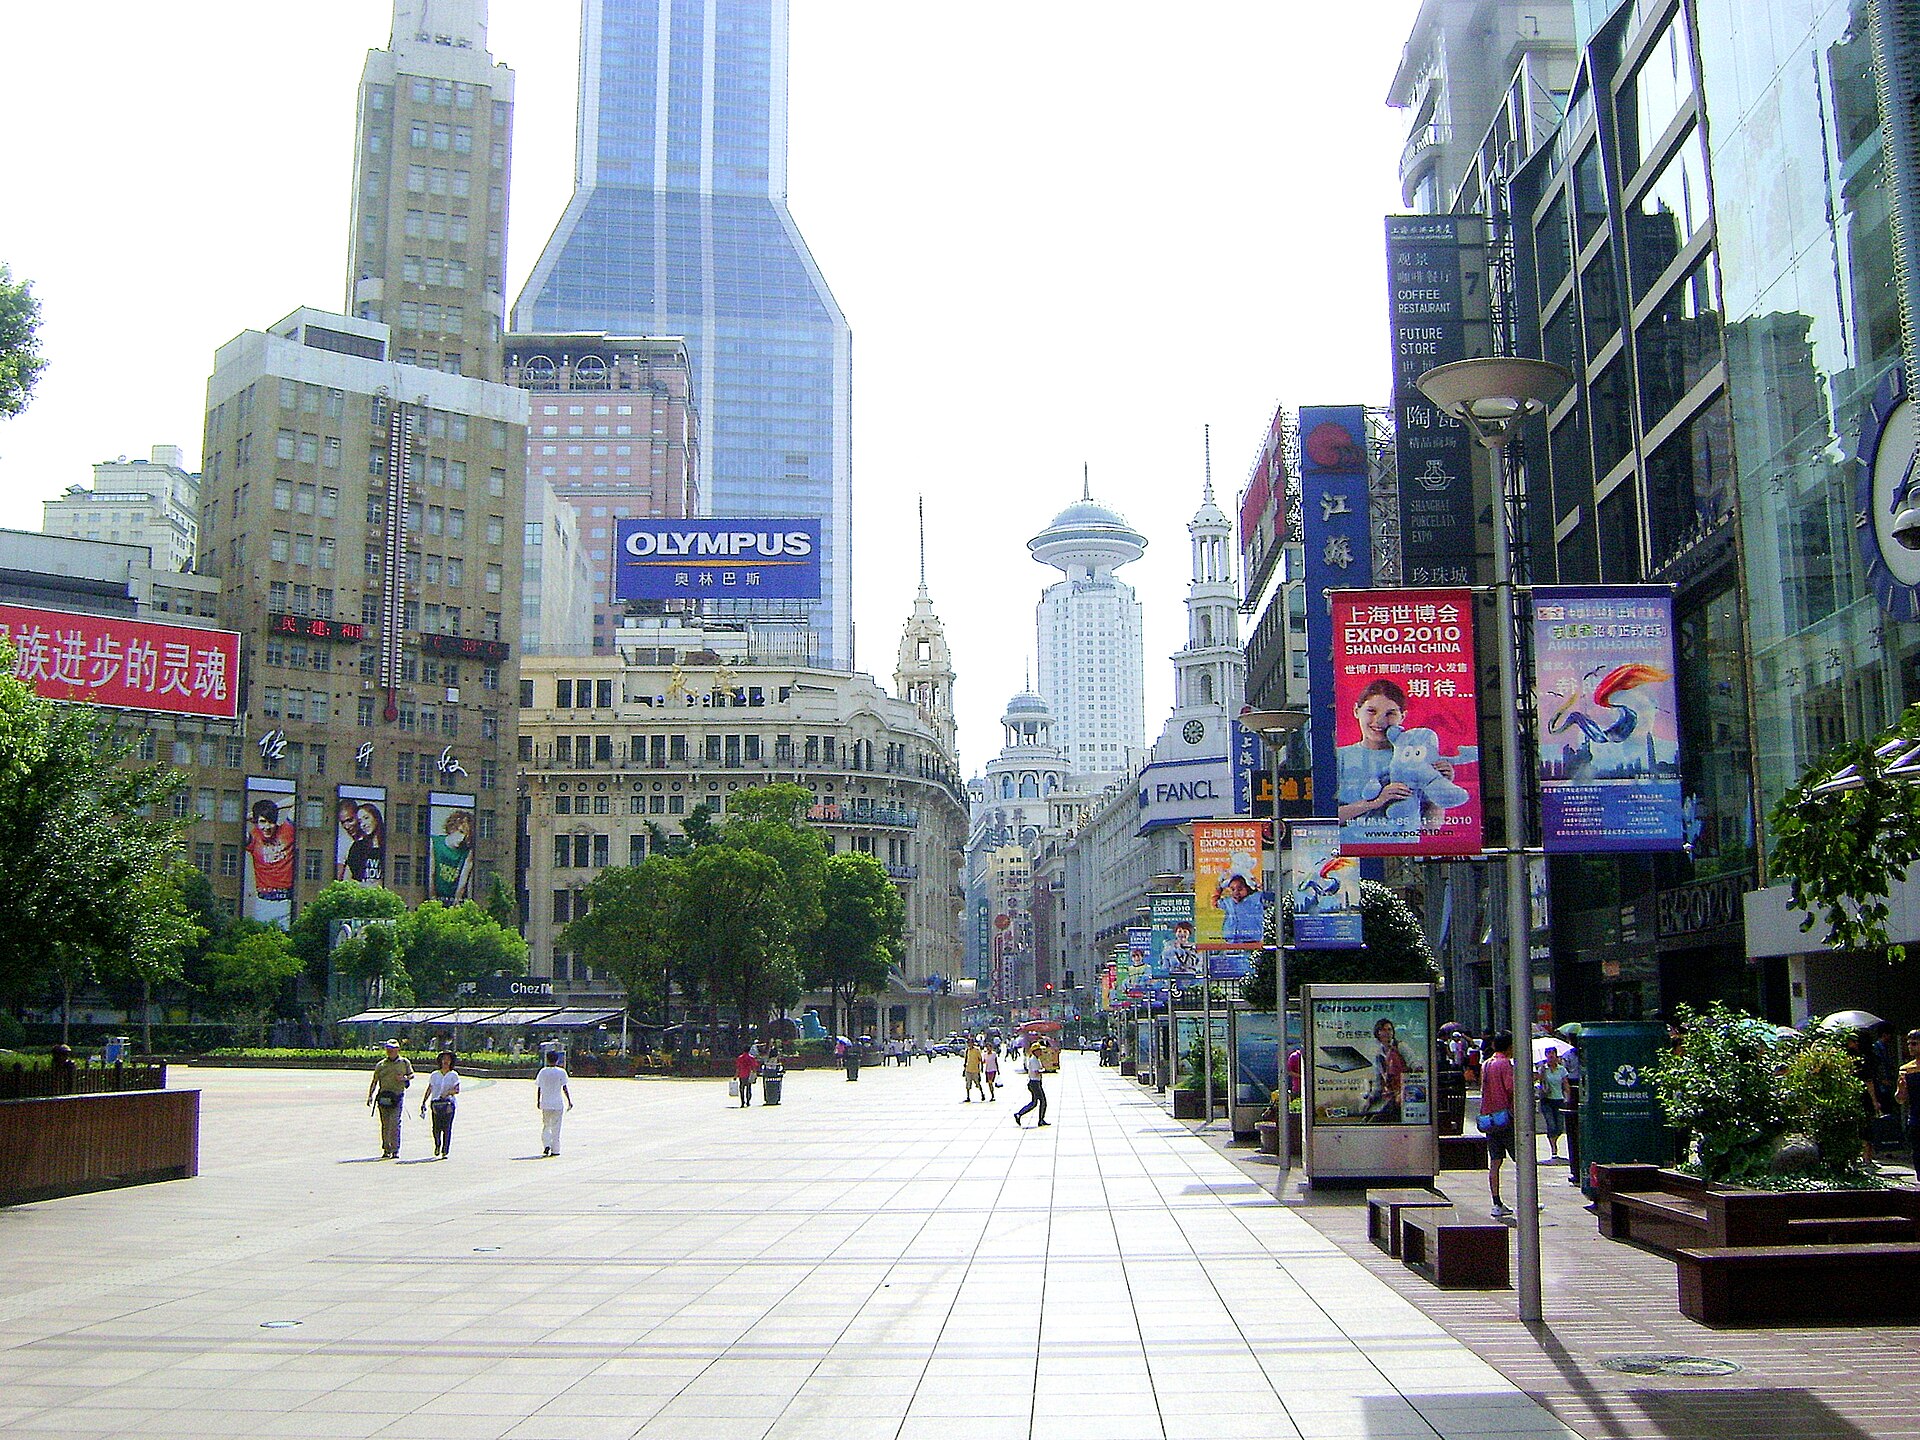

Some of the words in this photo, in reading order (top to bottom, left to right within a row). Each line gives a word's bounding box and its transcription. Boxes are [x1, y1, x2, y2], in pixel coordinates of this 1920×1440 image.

[1398, 289, 1440, 300] COFFEE
[1398, 302, 1451, 314] RESTAURANT
[1399, 328, 1443, 340] FUTURE
[1400, 342, 1437, 355] STORE
[626, 531, 811, 557] OLYMPUS
[675, 572, 760, 587] 奥林巴斯
[1413, 566, 1469, 584] 珍珠城
[1344, 603, 1459, 626] 上海世博会
[1344, 628, 1399, 643] EXPO
[1403, 626, 1461, 642] 2010
[1345, 644, 1416, 655] SHANGHAI
[1418, 642, 1461, 654] CHINA
[1344, 662, 1468, 675] 世博门票即将向个人发售
[1157, 780, 1219, 802] FANCL
[1364, 829, 1454, 838] www.expo2010.cn
[1200, 839, 1226, 847] EXPO
[1228, 839, 1256, 847] 2010
[511, 983, 540, 995] Chez
